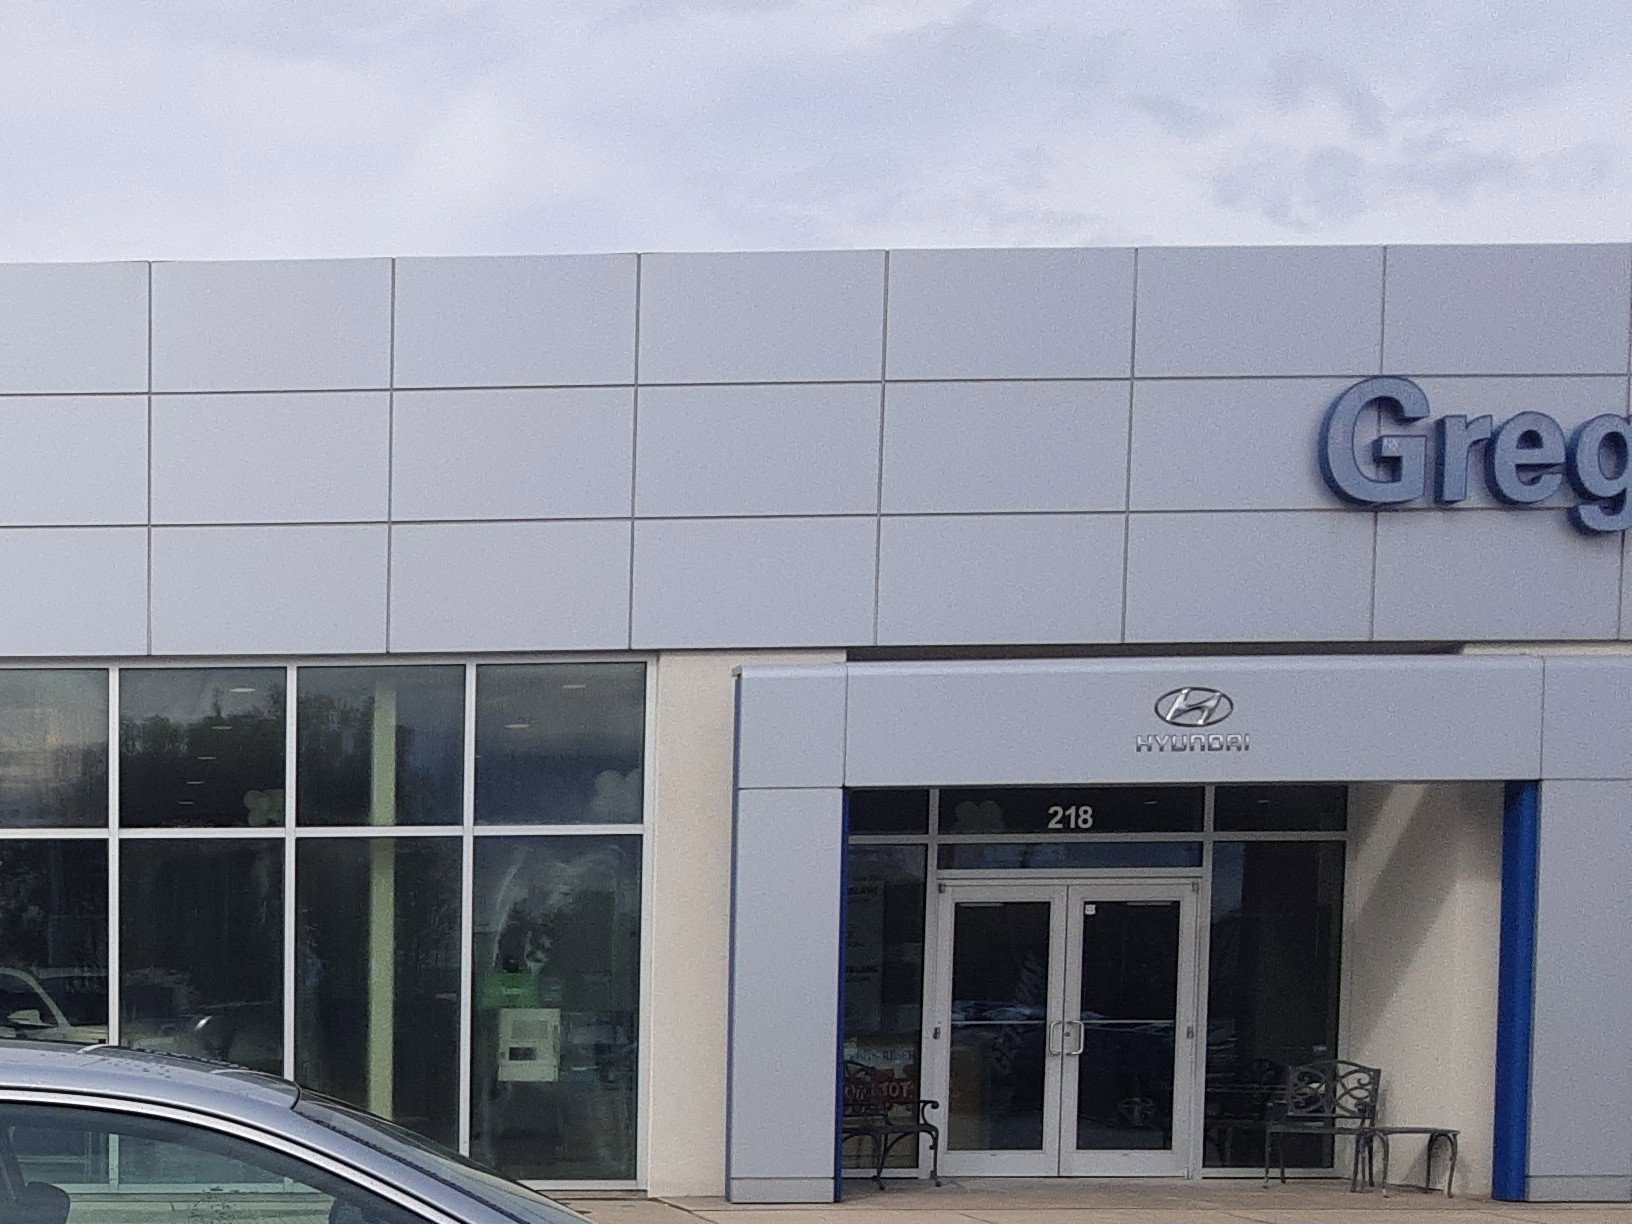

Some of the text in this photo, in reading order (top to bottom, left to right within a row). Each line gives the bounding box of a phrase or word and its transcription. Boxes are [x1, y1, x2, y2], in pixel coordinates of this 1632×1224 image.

[1319, 375, 1632, 535] Greg
[1136, 733, 1250, 752] HYUNDAI
[1047, 805, 1093, 829] 218
